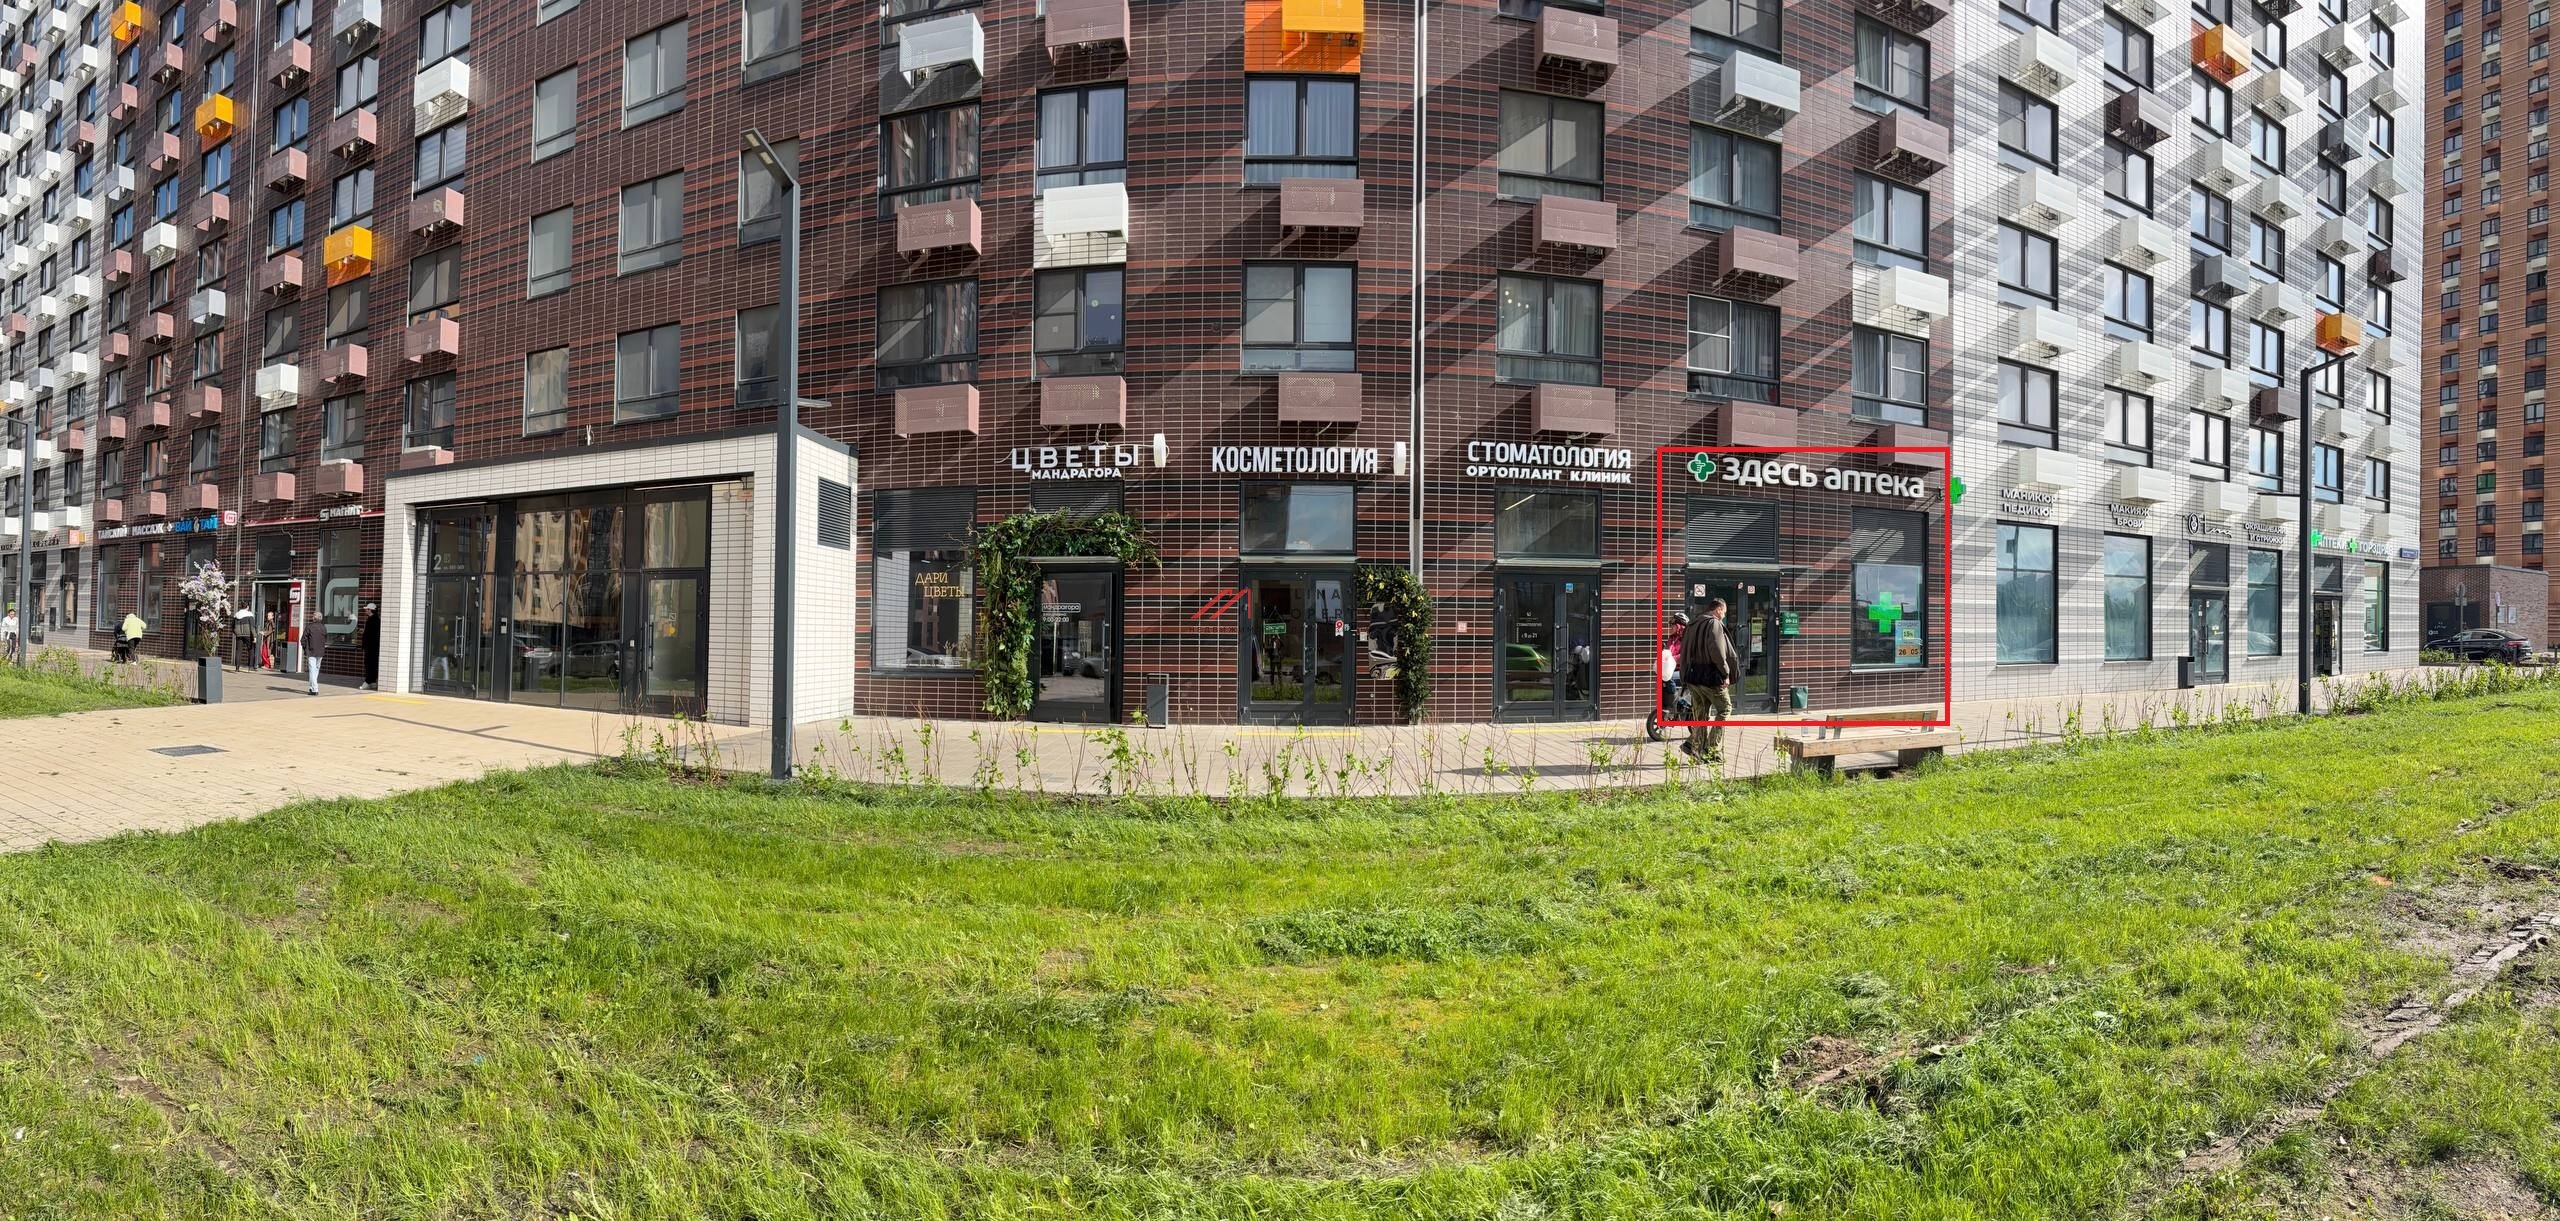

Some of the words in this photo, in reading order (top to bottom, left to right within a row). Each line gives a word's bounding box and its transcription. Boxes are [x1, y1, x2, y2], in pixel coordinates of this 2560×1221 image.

[1011, 444, 1139, 473] ЦВЕТЫ
[1212, 446, 1378, 473] КОСМЕТОЛОГИЯ
[1467, 441, 1631, 469] СТОМАТОЛОГИЯ
[1031, 467, 1122, 480] МАНДРАГОРА
[1466, 465, 1562, 481] ОРТОПЛАНТ
[1570, 470, 1632, 485] КЛИНИК
[1823, 467, 1925, 498] аптека
[2002, 488, 2056, 504] МАНИКЮР
[2003, 503, 2056, 518] ПЕДИКЮР
[2110, 503, 2151, 519] МАКИЯЖ
[132, 523, 164, 536] МАССАЖ
[2115, 517, 2145, 529] БРОВИ
[434, 554, 442, 570] 2
[915, 572, 948, 586] ДАРИ
[924, 586, 965, 598] ЦВЕТЫ
